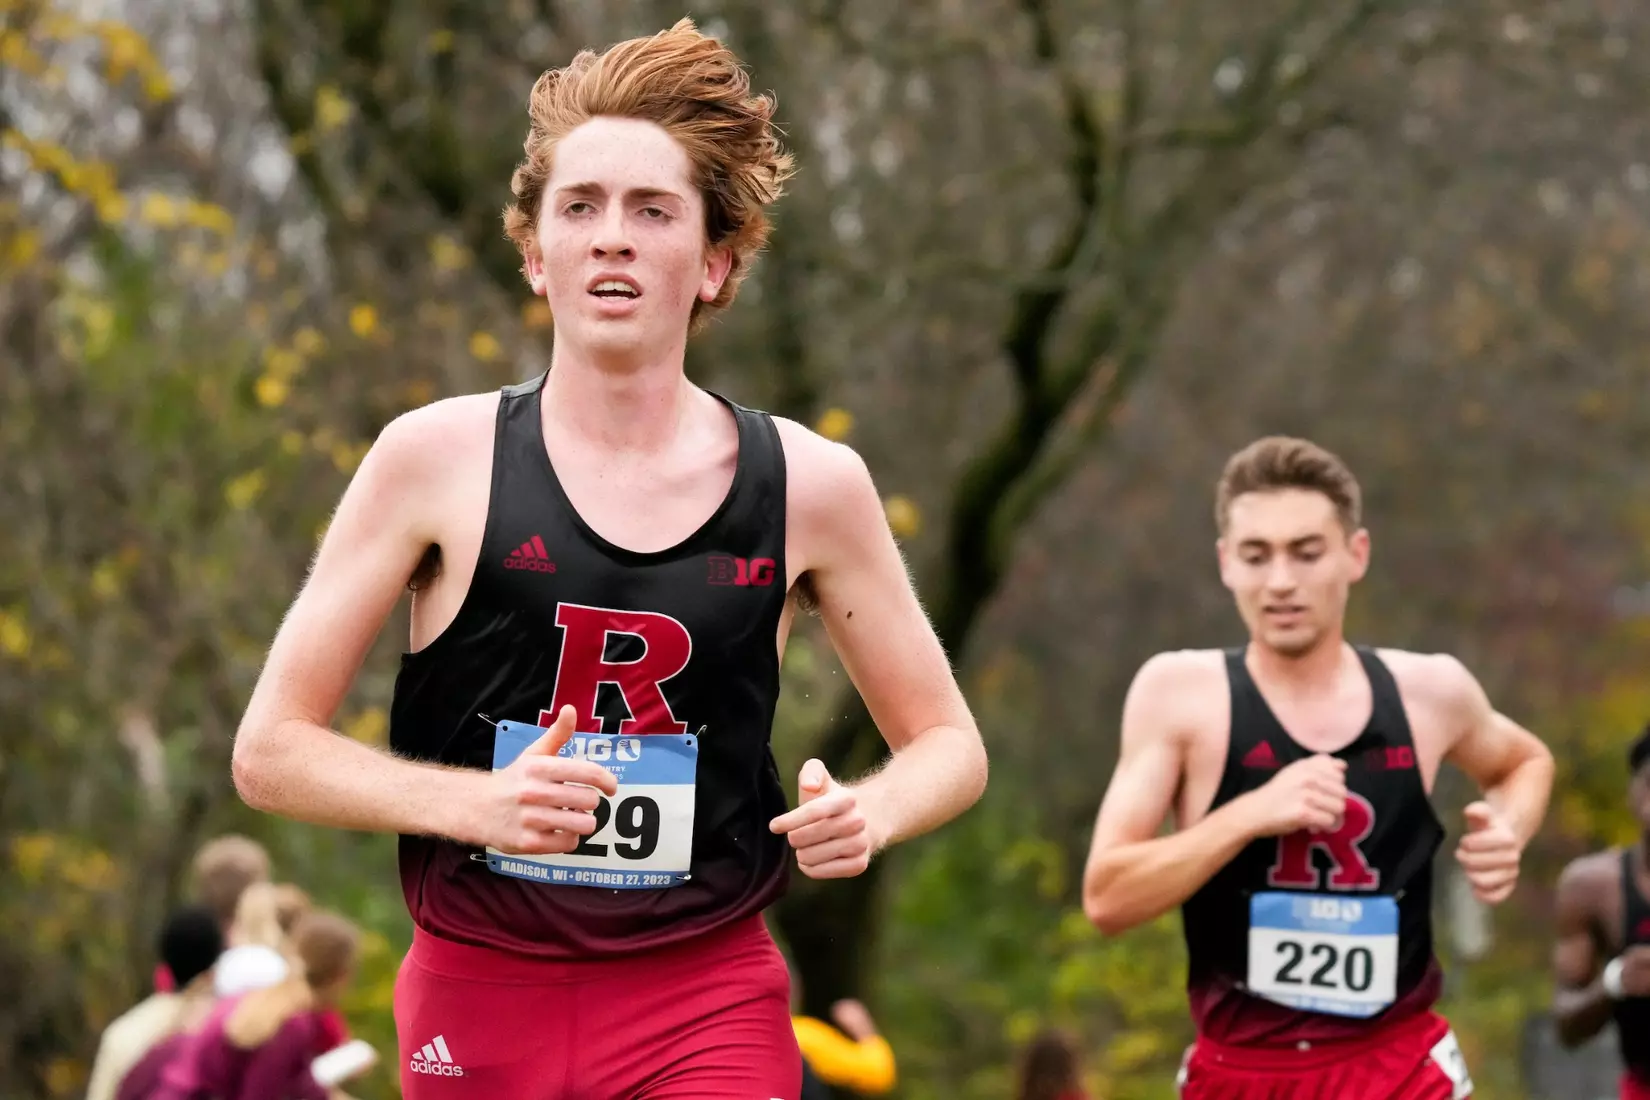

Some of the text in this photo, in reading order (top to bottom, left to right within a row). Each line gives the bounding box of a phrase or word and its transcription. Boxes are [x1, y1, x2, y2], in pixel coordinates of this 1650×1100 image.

[503, 556, 557, 574] adidas
[537, 602, 692, 736] R
[563, 795, 660, 860] 29
[1267, 790, 1380, 890] R
[501, 860, 671, 886] MADISON, WI OCTOBER 27, 2023
[1274, 940, 1374, 992] 220
[410, 1060, 464, 1077] adidas
